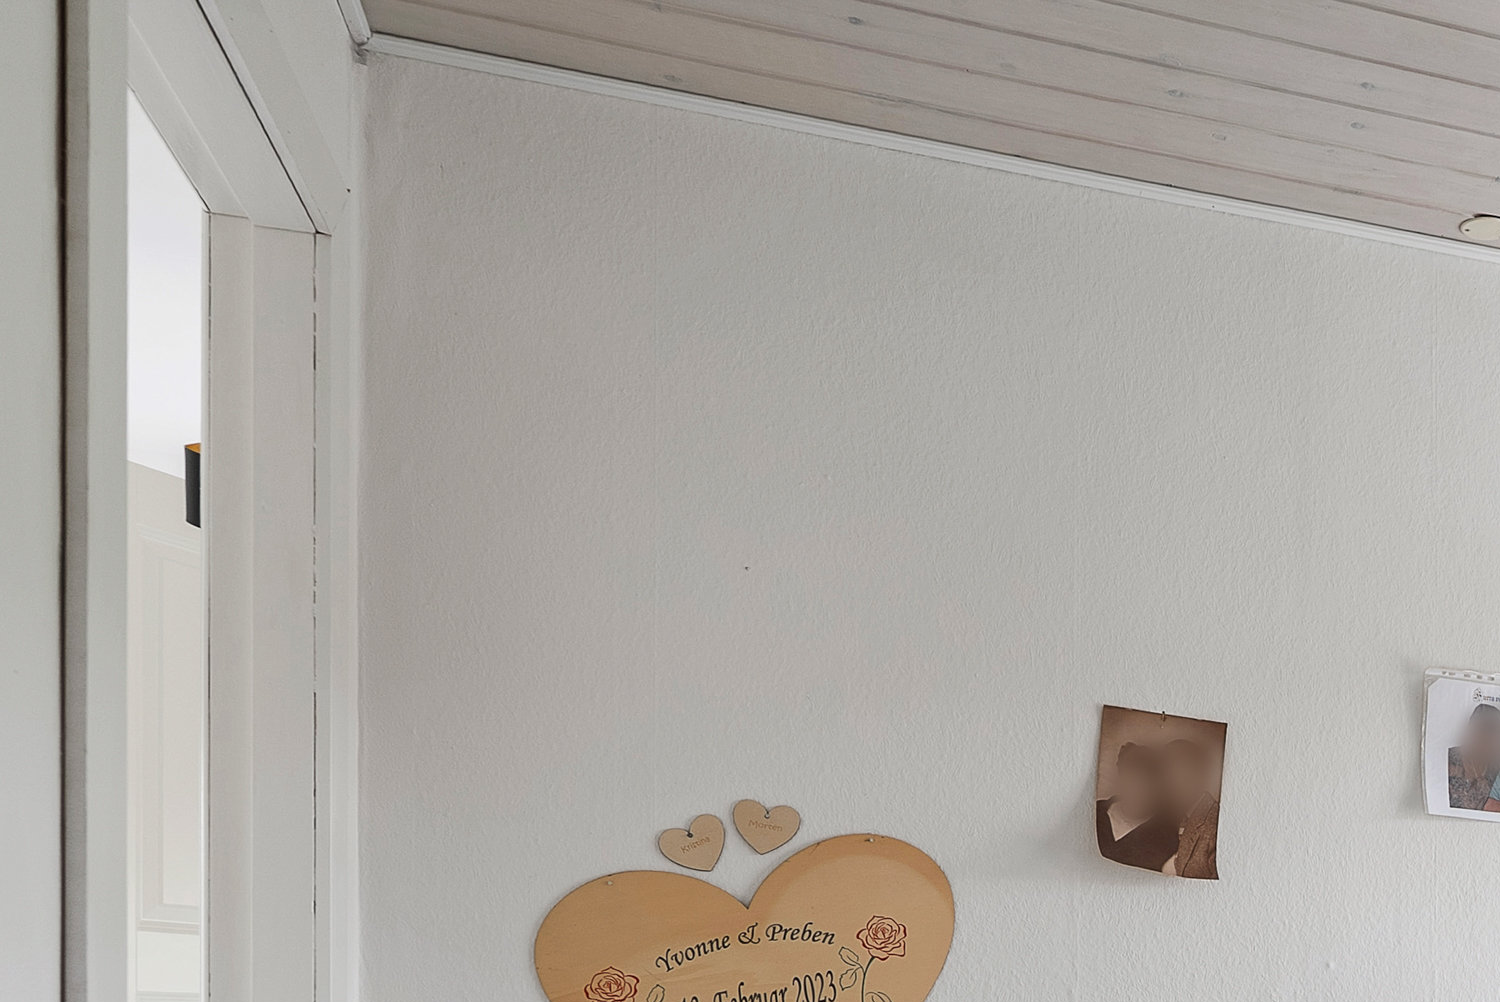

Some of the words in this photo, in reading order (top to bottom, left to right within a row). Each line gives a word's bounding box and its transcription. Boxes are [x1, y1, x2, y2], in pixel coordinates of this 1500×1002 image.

[655, 936, 731, 973] Yvonne
[737, 922, 761, 945] &
[765, 921, 836, 945] Preben
